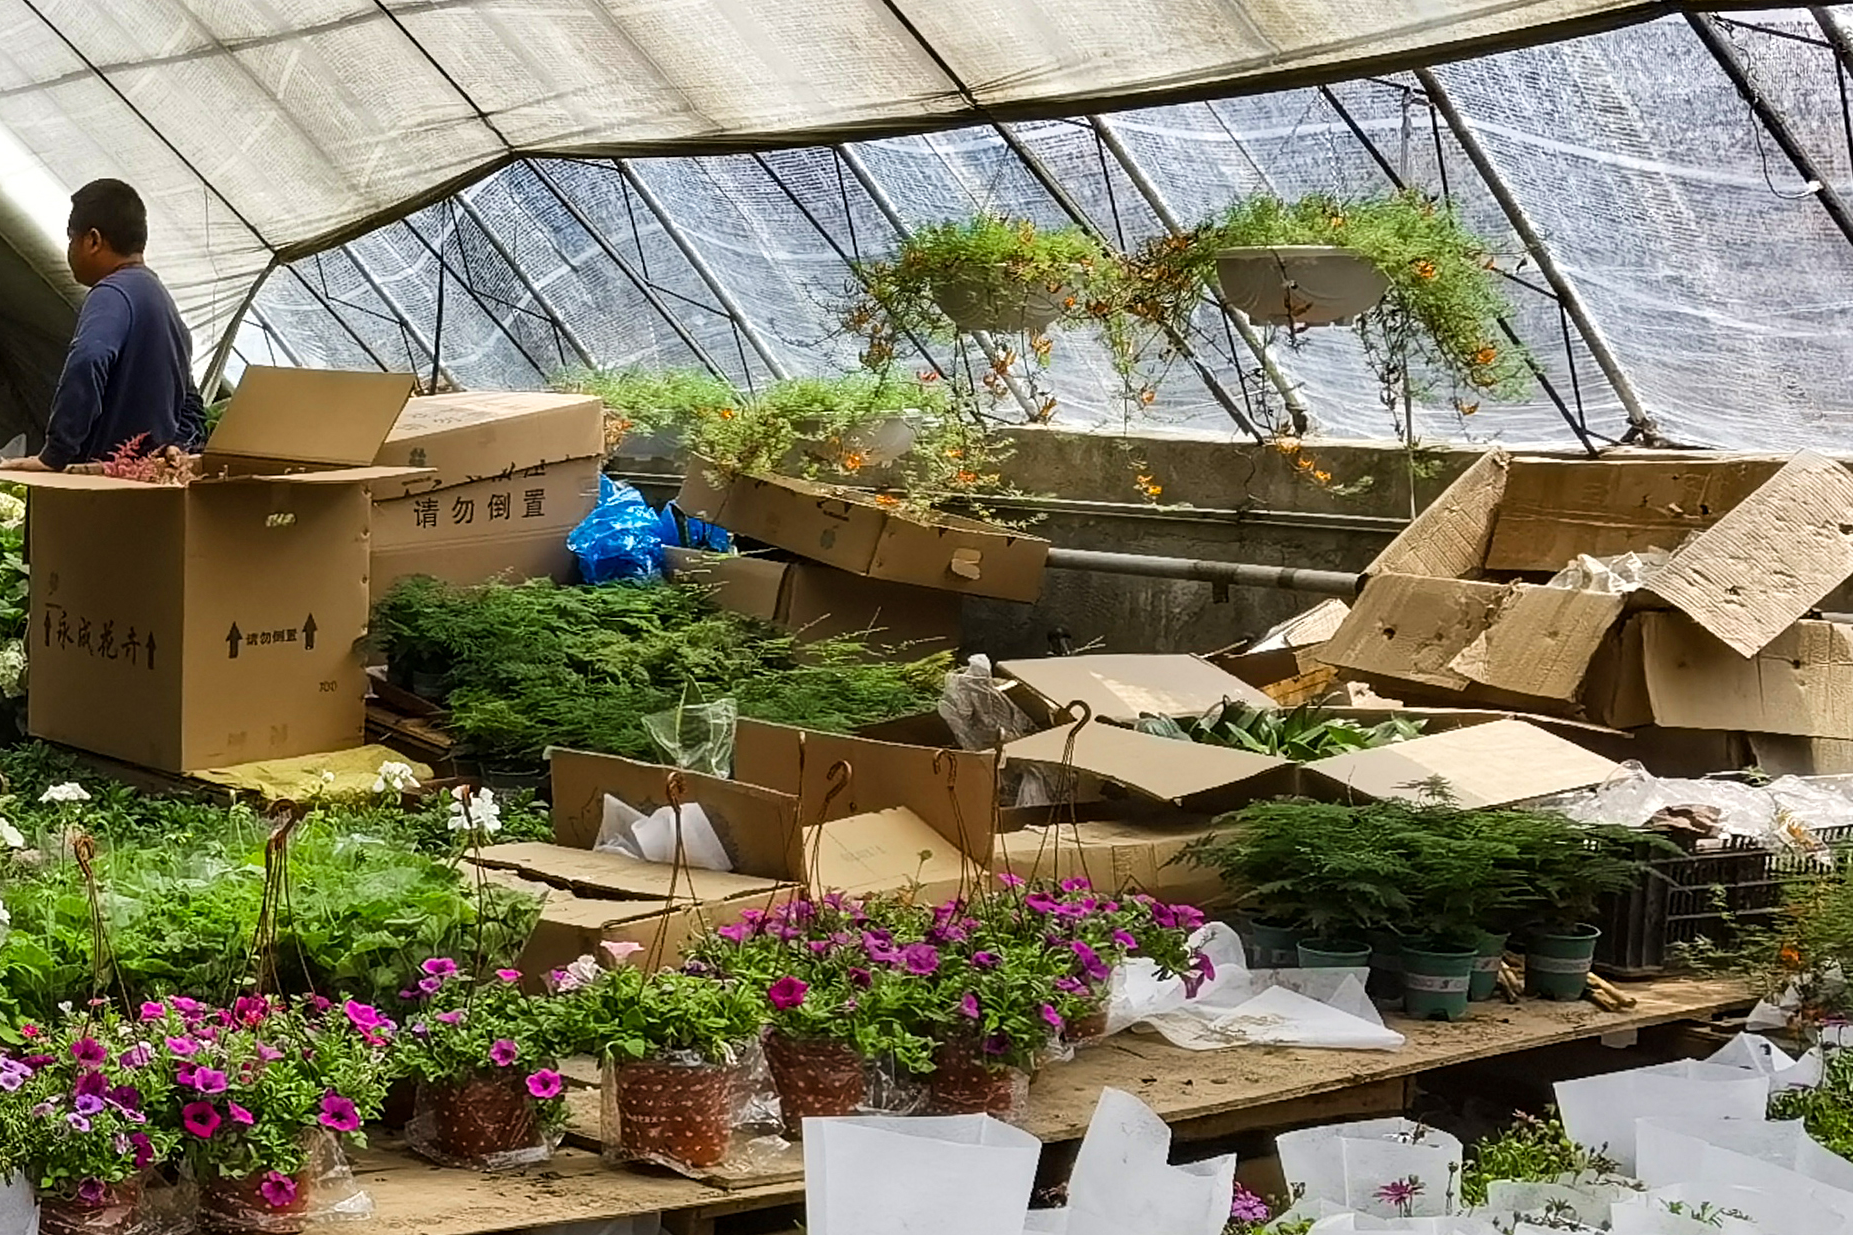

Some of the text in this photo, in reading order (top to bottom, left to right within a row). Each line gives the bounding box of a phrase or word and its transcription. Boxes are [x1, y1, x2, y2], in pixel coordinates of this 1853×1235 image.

[413, 488, 546, 529] 请勿倒置
[245, 628, 298, 646] 请勿倒置
